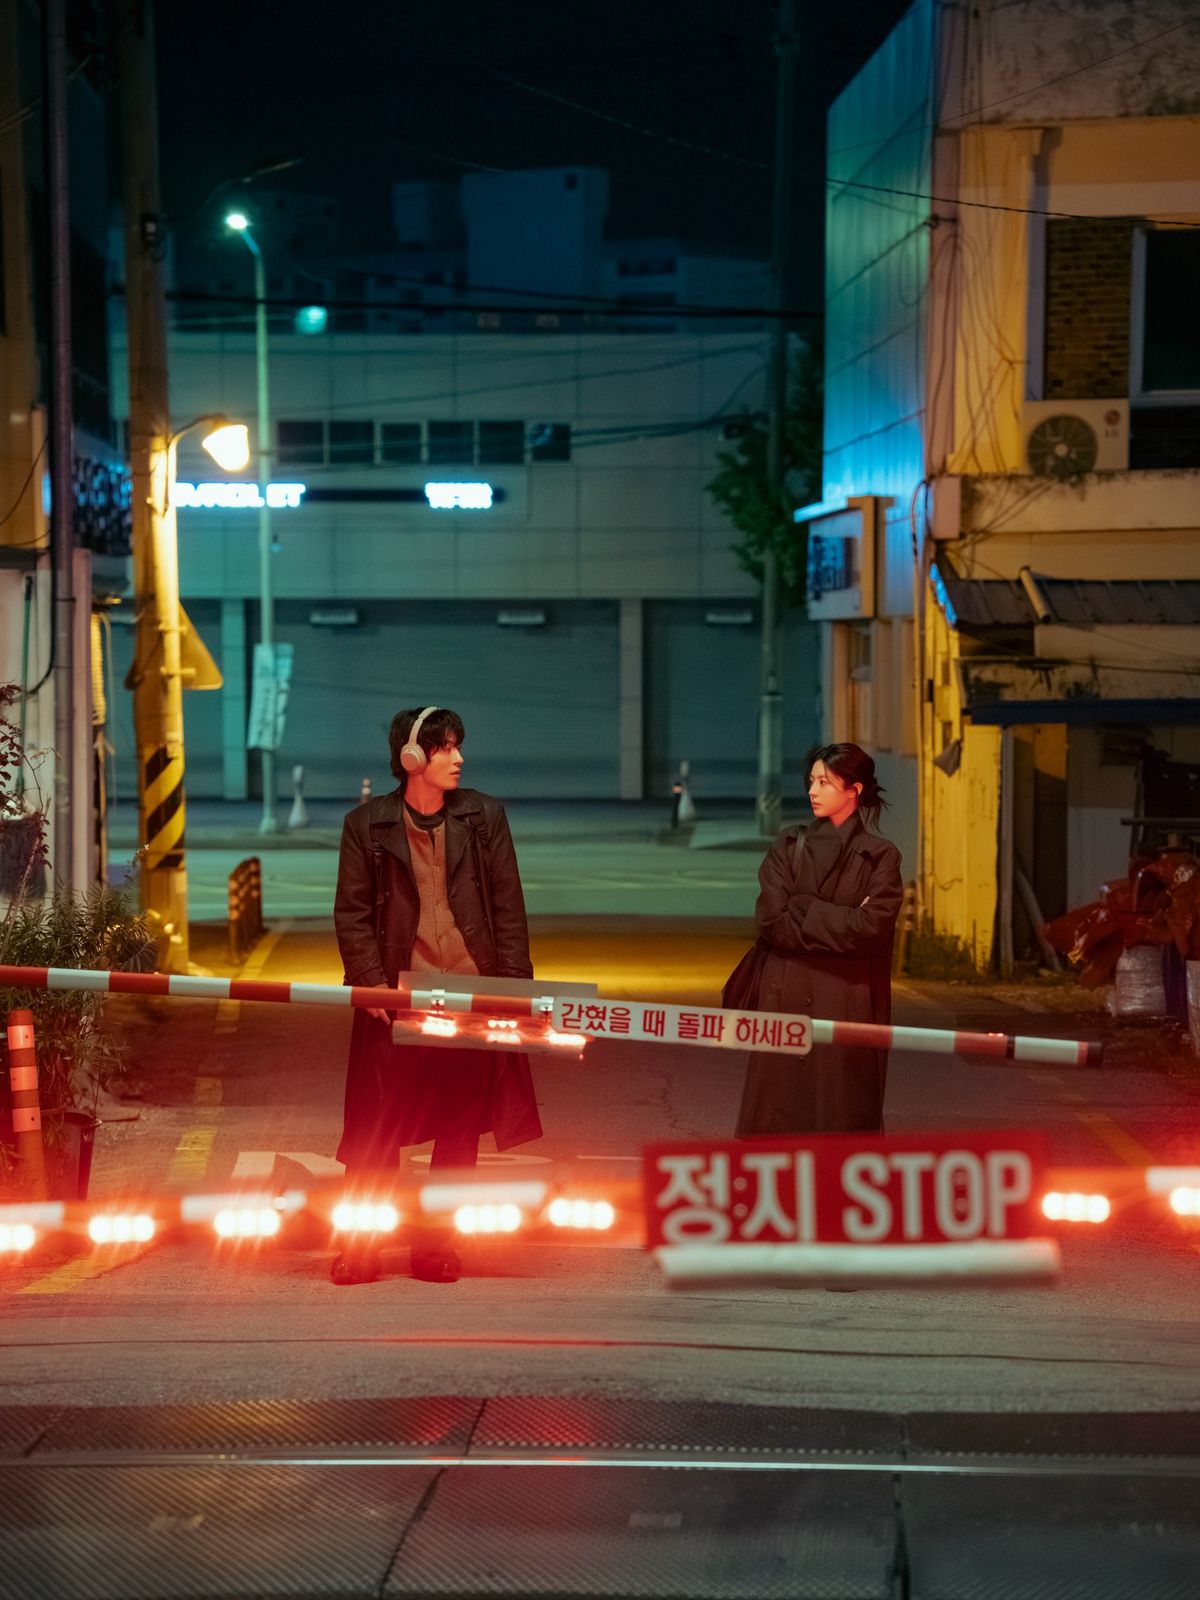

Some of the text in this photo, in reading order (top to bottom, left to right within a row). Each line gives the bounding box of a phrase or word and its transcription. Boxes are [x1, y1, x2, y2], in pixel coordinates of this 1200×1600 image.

[560, 1002, 807, 1048] 갇혔을 때 돌파 하세요
[656, 1150, 1032, 1244] 정지 STOP
